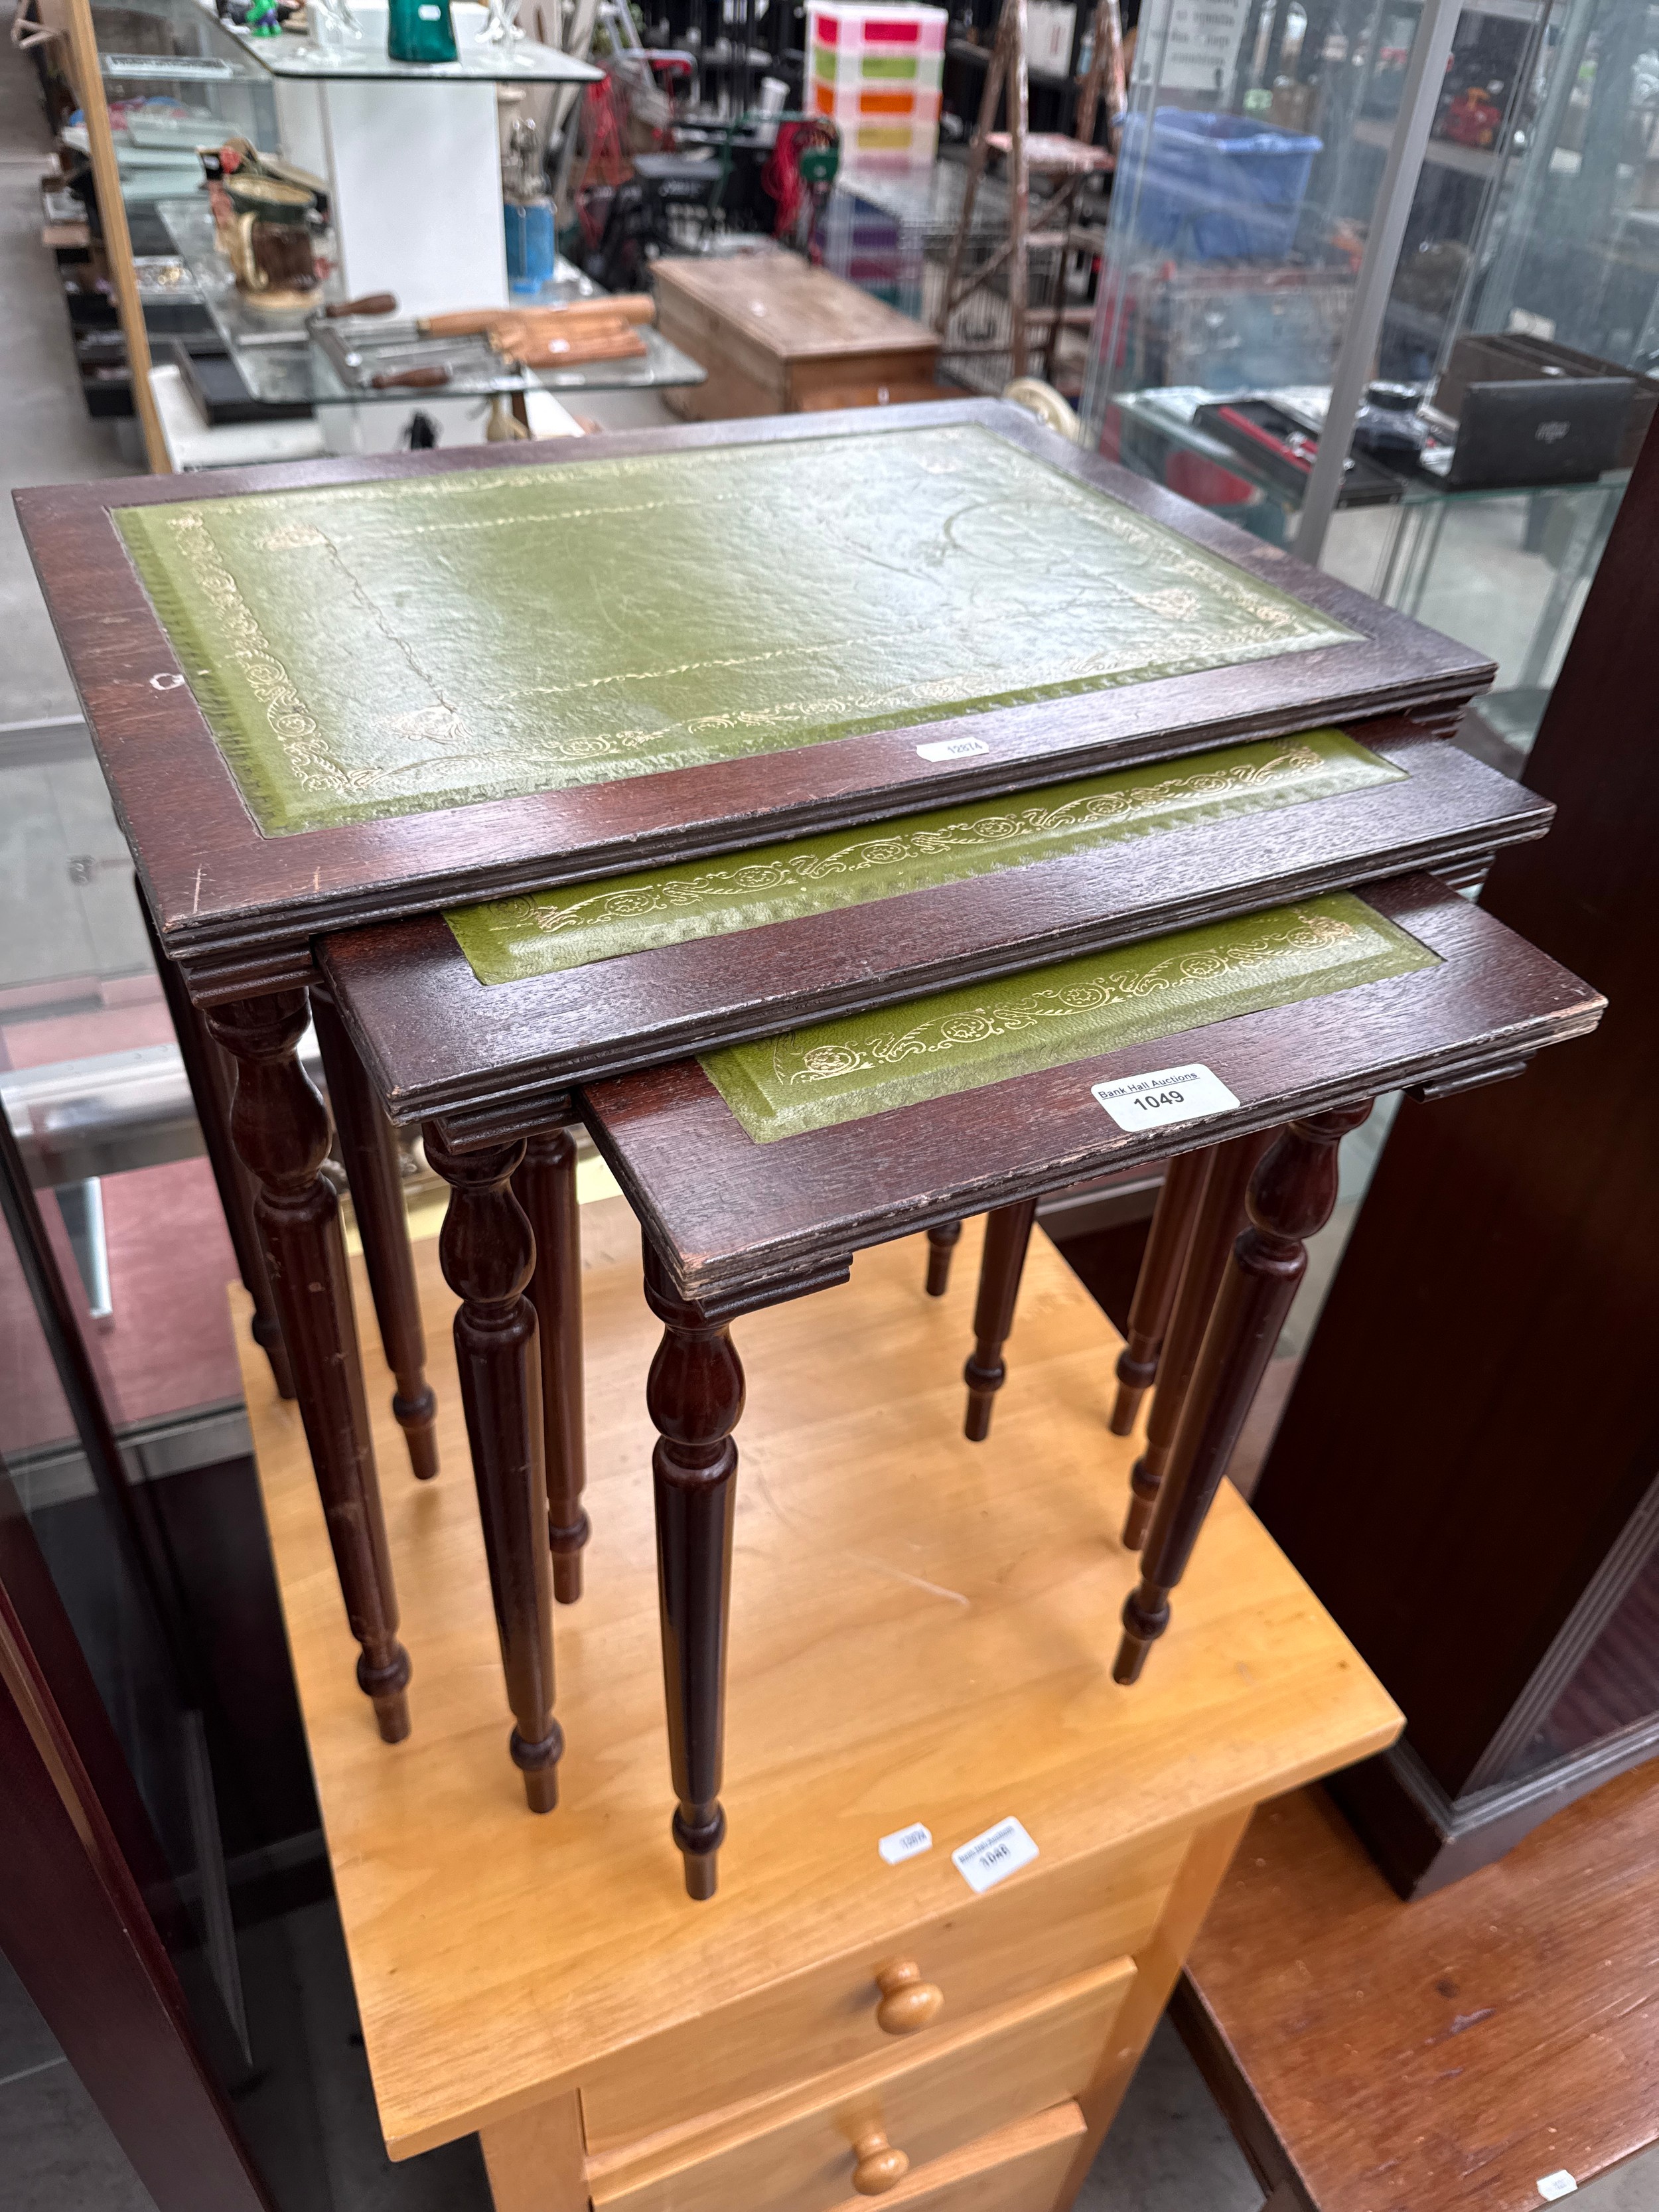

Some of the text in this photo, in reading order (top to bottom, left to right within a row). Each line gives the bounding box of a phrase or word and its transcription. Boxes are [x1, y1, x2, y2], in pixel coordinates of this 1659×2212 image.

[1098, 1072, 1198, 1098] Bank Hall Auctions
[1133, 1090, 1185, 1110] 1049
